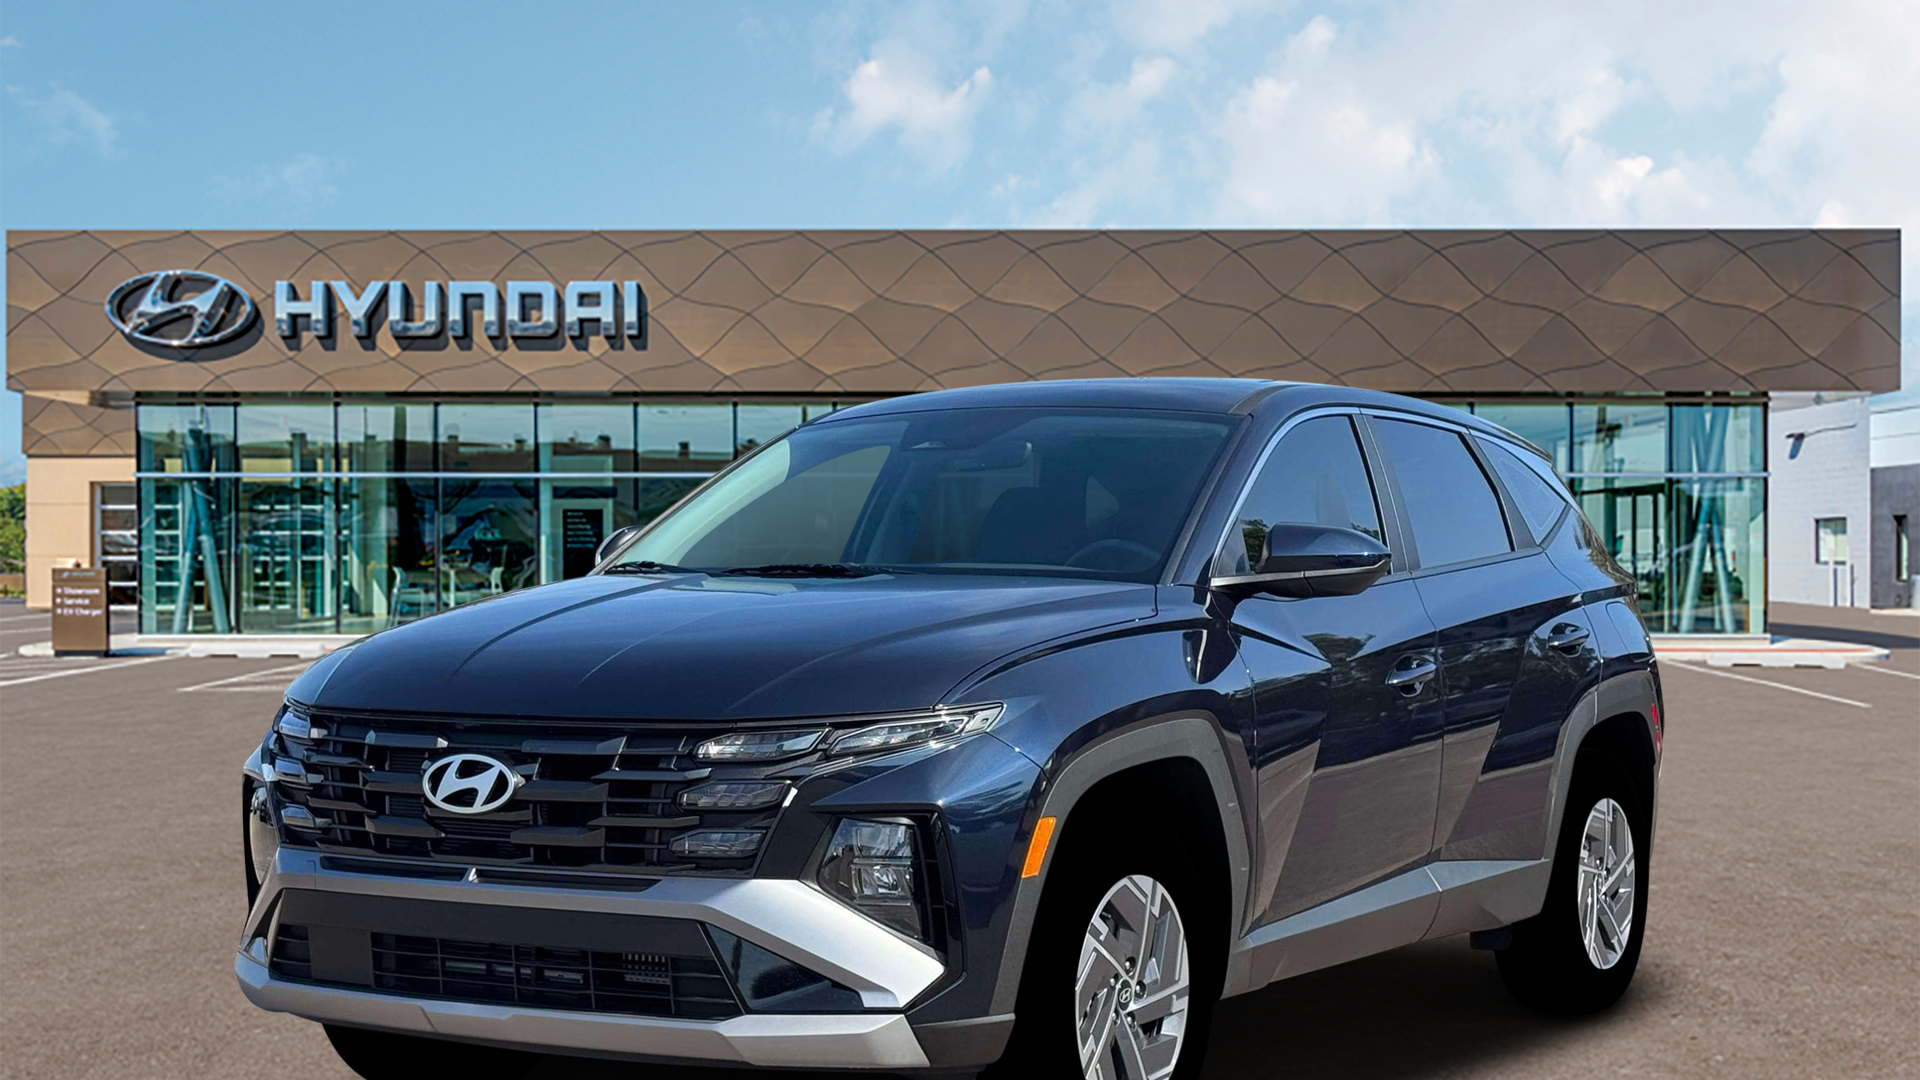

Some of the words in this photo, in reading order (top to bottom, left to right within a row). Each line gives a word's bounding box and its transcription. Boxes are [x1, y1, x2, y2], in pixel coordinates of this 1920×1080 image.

[274, 280, 642, 341] HYUNDAI
[63, 587, 100, 595] Showroom
[75, 607, 102, 617] Charger
